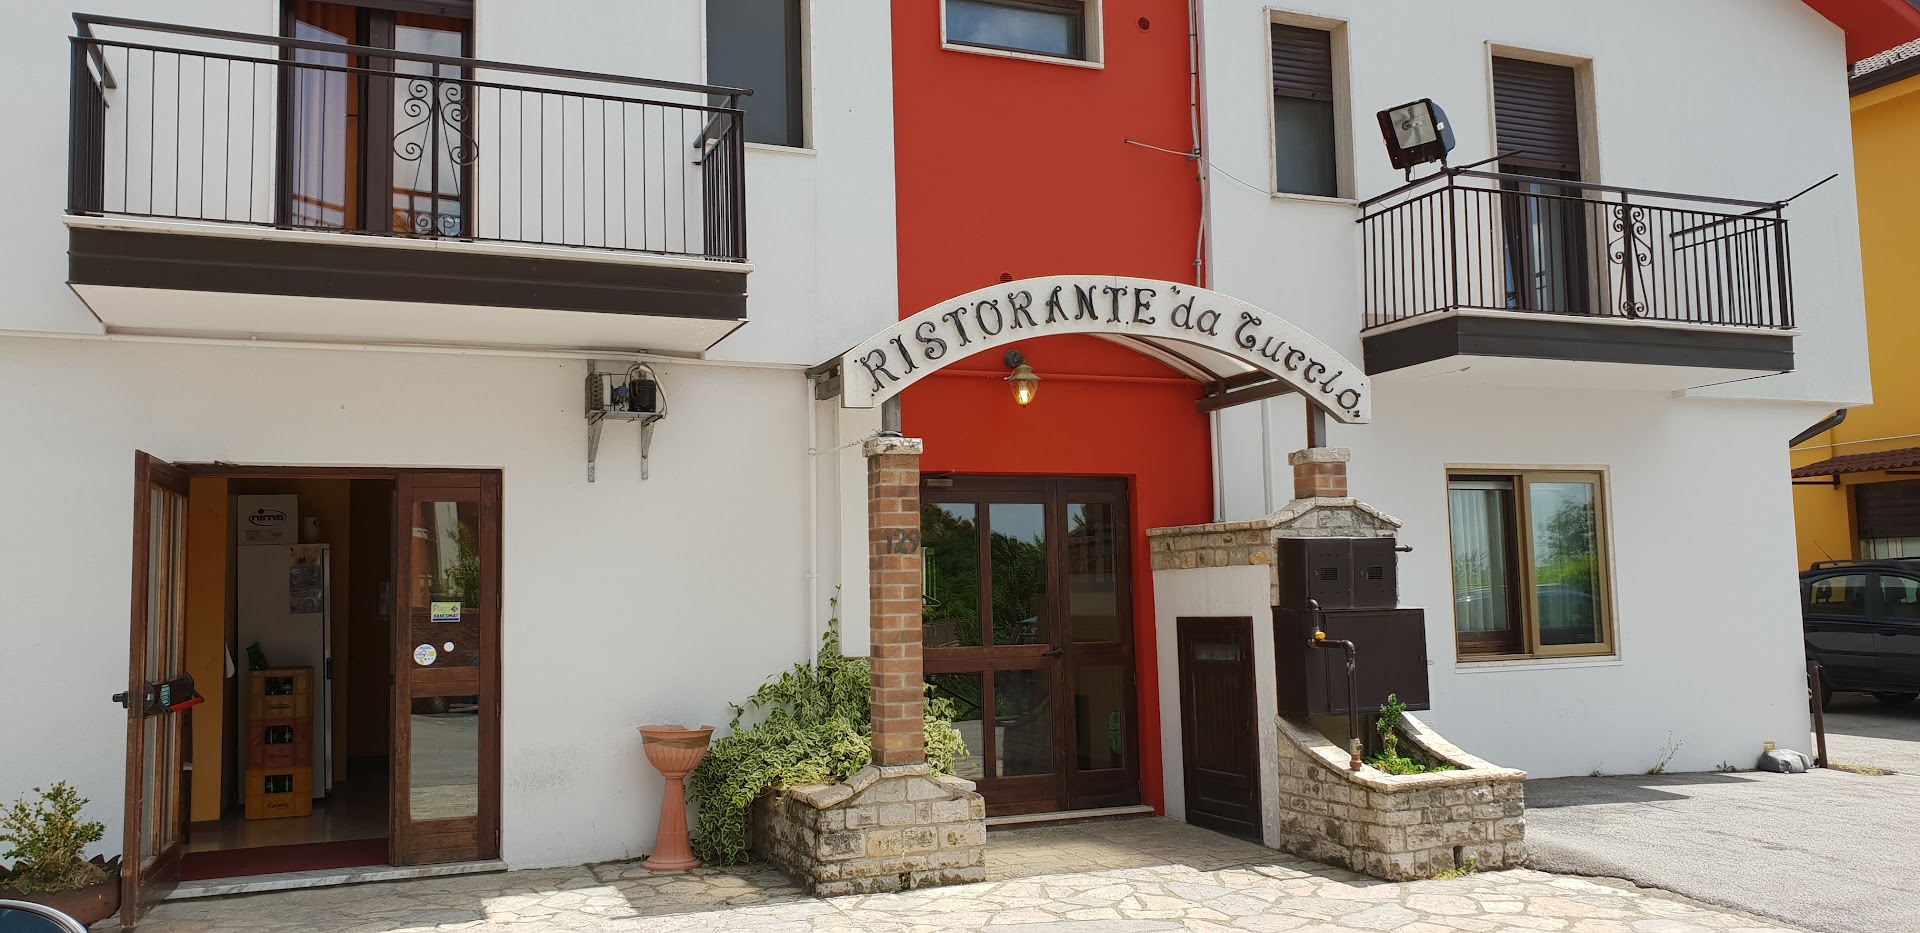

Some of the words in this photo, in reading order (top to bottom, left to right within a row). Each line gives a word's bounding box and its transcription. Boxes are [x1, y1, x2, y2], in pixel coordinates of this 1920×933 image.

[860, 284, 1156, 393] RISTORANTE
[251, 508, 284, 522] nims
[882, 528, 922, 554] 129
[433, 604, 451, 613] Pago
